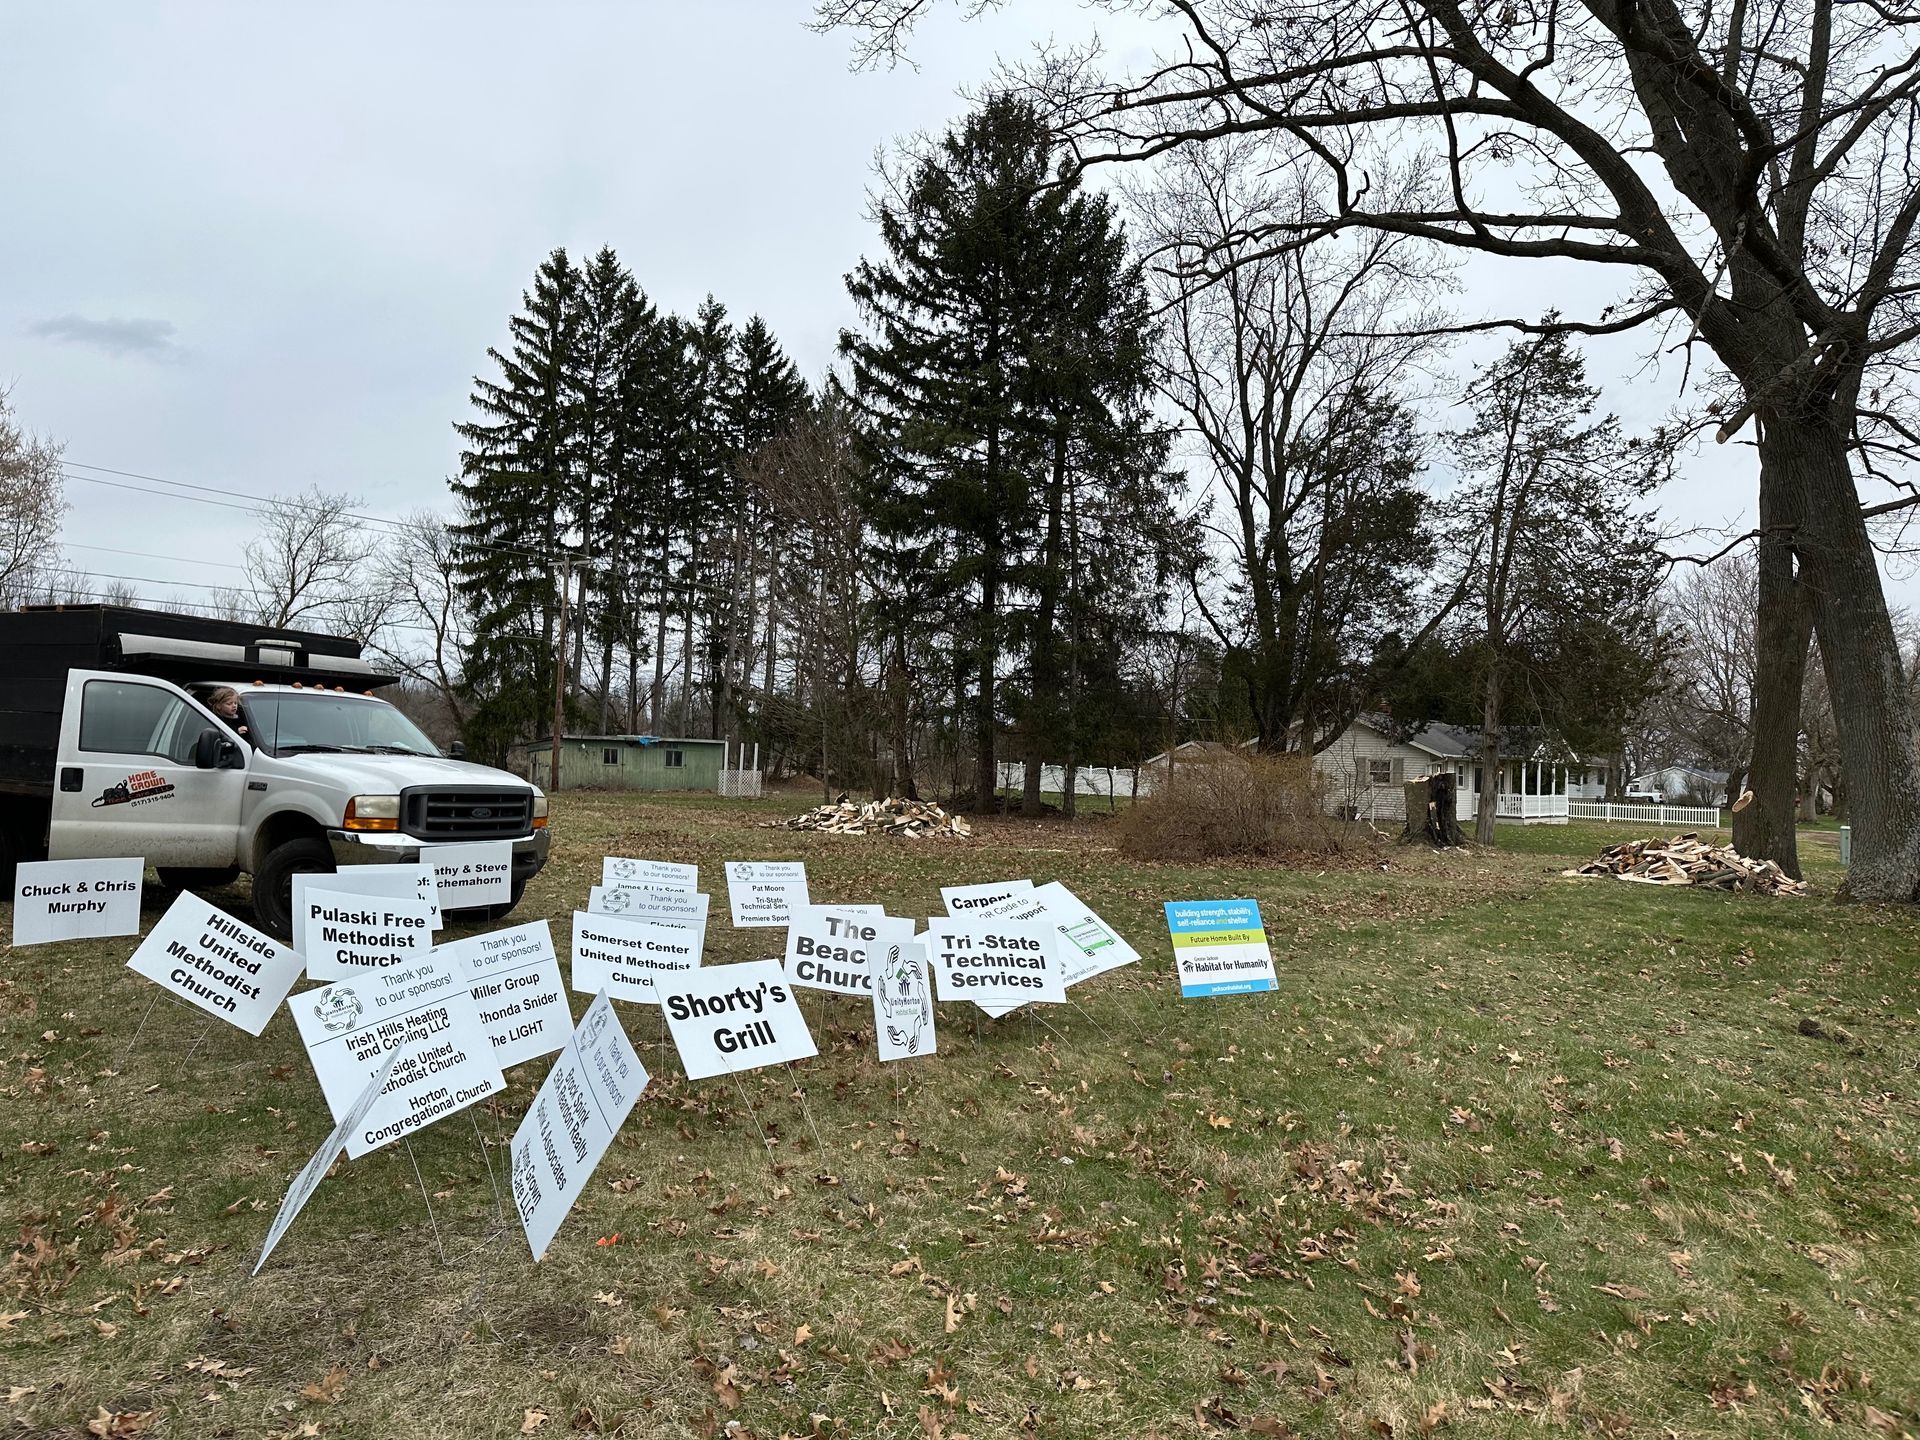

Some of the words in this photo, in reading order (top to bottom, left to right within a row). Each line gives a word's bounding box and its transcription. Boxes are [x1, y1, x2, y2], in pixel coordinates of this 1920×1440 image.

[128, 770, 157, 784] HOME
[131, 777, 166, 791] GROWN
[434, 866, 459, 876] athy
[462, 864, 471, 874] &
[475, 864, 508, 873] Steve
[651, 864, 669, 872] Thank
[22, 883, 70, 897] Chuck
[76, 882, 88, 893] &
[94, 880, 136, 892] Chris
[436, 876, 502, 888] chemahorn
[48, 900, 106, 914] Murphy
[650, 894, 672, 903] Thank
[662, 904, 698, 912] sponsors!
[994, 902, 1018, 915] Code
[311, 904, 376, 926] Pulaski
[384, 912, 426, 928] Free
[1174, 909, 1200, 918] building
[1200, 908, 1227, 917] strength,
[1228, 908, 1252, 916] stability,
[1176, 918, 1216, 927] self-reliance
[1228, 916, 1248, 924] shelter
[206, 913, 276, 960] Hillside
[322, 927, 415, 948] Methodist
[826, 916, 876, 942] The
[1190, 936, 1210, 944] Future
[1242, 934, 1250, 942] By
[480, 936, 510, 952] Thank
[511, 932, 527, 945] you
[581, 929, 642, 950] Somerset
[646, 941, 690, 954] Center
[796, 936, 866, 964] Beac
[941, 934, 971, 950] Tri
[978, 935, 1040, 951] -State
[199, 933, 262, 976] United
[336, 950, 402, 968] Church
[472, 958, 482, 968] to
[484, 953, 500, 965] our
[502, 941, 542, 962] sponsors!
[580, 948, 622, 964] United
[626, 956, 690, 970] Methodist
[941, 954, 1046, 970] Technical
[1195, 960, 1222, 972] Habitat
[1223, 961, 1234, 970] for
[1234, 958, 1268, 970] Humanity
[166, 941, 261, 1000] Methodist
[381, 969, 414, 988] Thank
[417, 964, 434, 980] you
[796, 960, 872, 990] Churc
[952, 972, 1044, 988] Services
[170, 968, 237, 1012] Church
[375, 996, 388, 1008] to
[388, 990, 406, 1003] our
[408, 973, 452, 1000] sponsors!
[470, 984, 502, 1000] Miller
[504, 973, 541, 991] Group
[522, 992, 558, 1012] Snider
[667, 982, 787, 1020] Shorty's
[346, 1030, 376, 1051] Irish
[376, 1022, 405, 1042] Hills
[405, 1006, 448, 1030] Heating
[357, 1042, 382, 1062] and
[428, 1016, 450, 1034] LLC
[488, 1034, 507, 1048] he
[509, 1020, 544, 1042] LIGHT
[713, 1020, 777, 1053] Grill
[418, 1042, 454, 1064] United
[594, 1046, 602, 1062] to
[597, 1056, 606, 1071] our
[608, 1036, 622, 1066] Thank
[616, 1060, 630, 1080] you
[380, 1066, 428, 1095] ethodist
[428, 1050, 466, 1074] Church
[554, 1068, 565, 1094] ERA
[566, 1067, 580, 1100] Brock
[408, 1086, 448, 1110] Horton
[602, 1068, 626, 1108] sponsors!
[364, 1094, 456, 1146] Congregational
[456, 1080, 492, 1104] Church
[558, 1084, 574, 1130] Reardon
[572, 1092, 591, 1128] Spink
[541, 1121, 550, 1138] &
[569, 1121, 588, 1164] Realty
[542, 1130, 567, 1192] Associates
[526, 1164, 542, 1206] Grown
[514, 1168, 524, 1200] Care
[520, 1191, 535, 1228] LLC.
